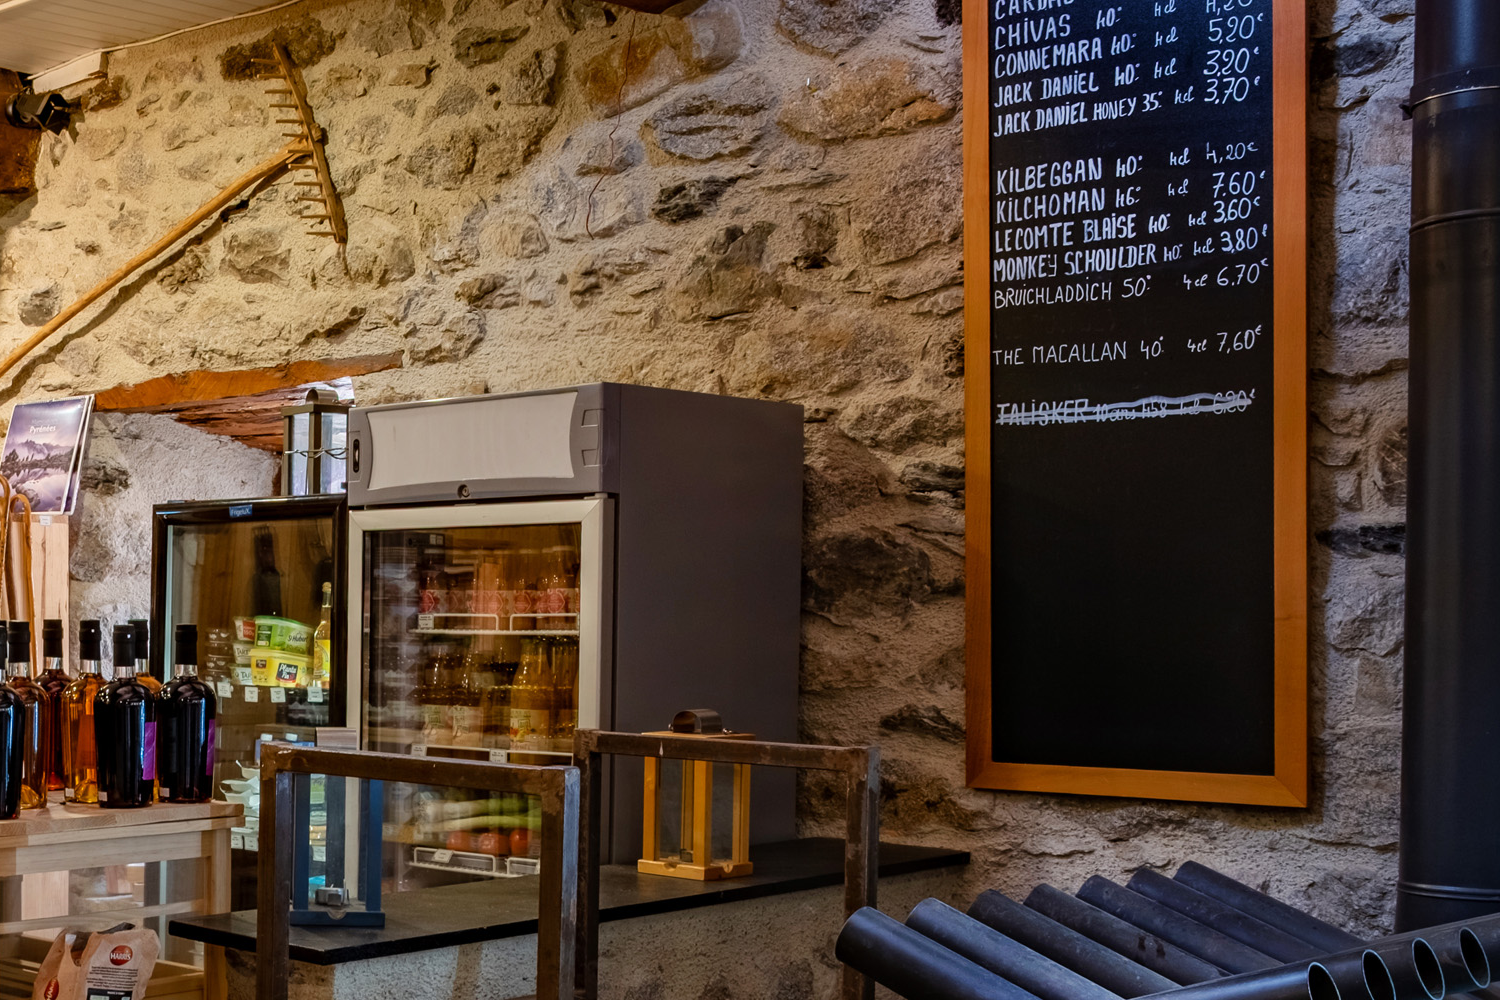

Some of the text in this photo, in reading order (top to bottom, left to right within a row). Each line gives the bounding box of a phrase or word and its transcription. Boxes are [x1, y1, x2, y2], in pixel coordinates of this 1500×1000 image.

[994, 0, 1075, 21] CAR
[994, 13, 1071, 50] CHIVAS
[994, 37, 1102, 79] CONNEMARA
[993, 81, 1033, 108] JACK
[1040, 70, 1099, 100] DANIEL
[993, 110, 1031, 138] JACK
[1034, 101, 1088, 131] DANIEL
[1091, 96, 1137, 121] HONEY
[995, 156, 1102, 196] KILBEGGAN
[995, 187, 1105, 224] KILCHOMAN
[1082, 212, 1137, 244] BLAISE
[993, 253, 1058, 282] MONKEY
[1064, 243, 1157, 276] SCHOULDER
[994, 276, 1113, 309] BRUICHLADDICH
[992, 347, 1025, 366] THE
[1032, 341, 1127, 364] MACALLAN
